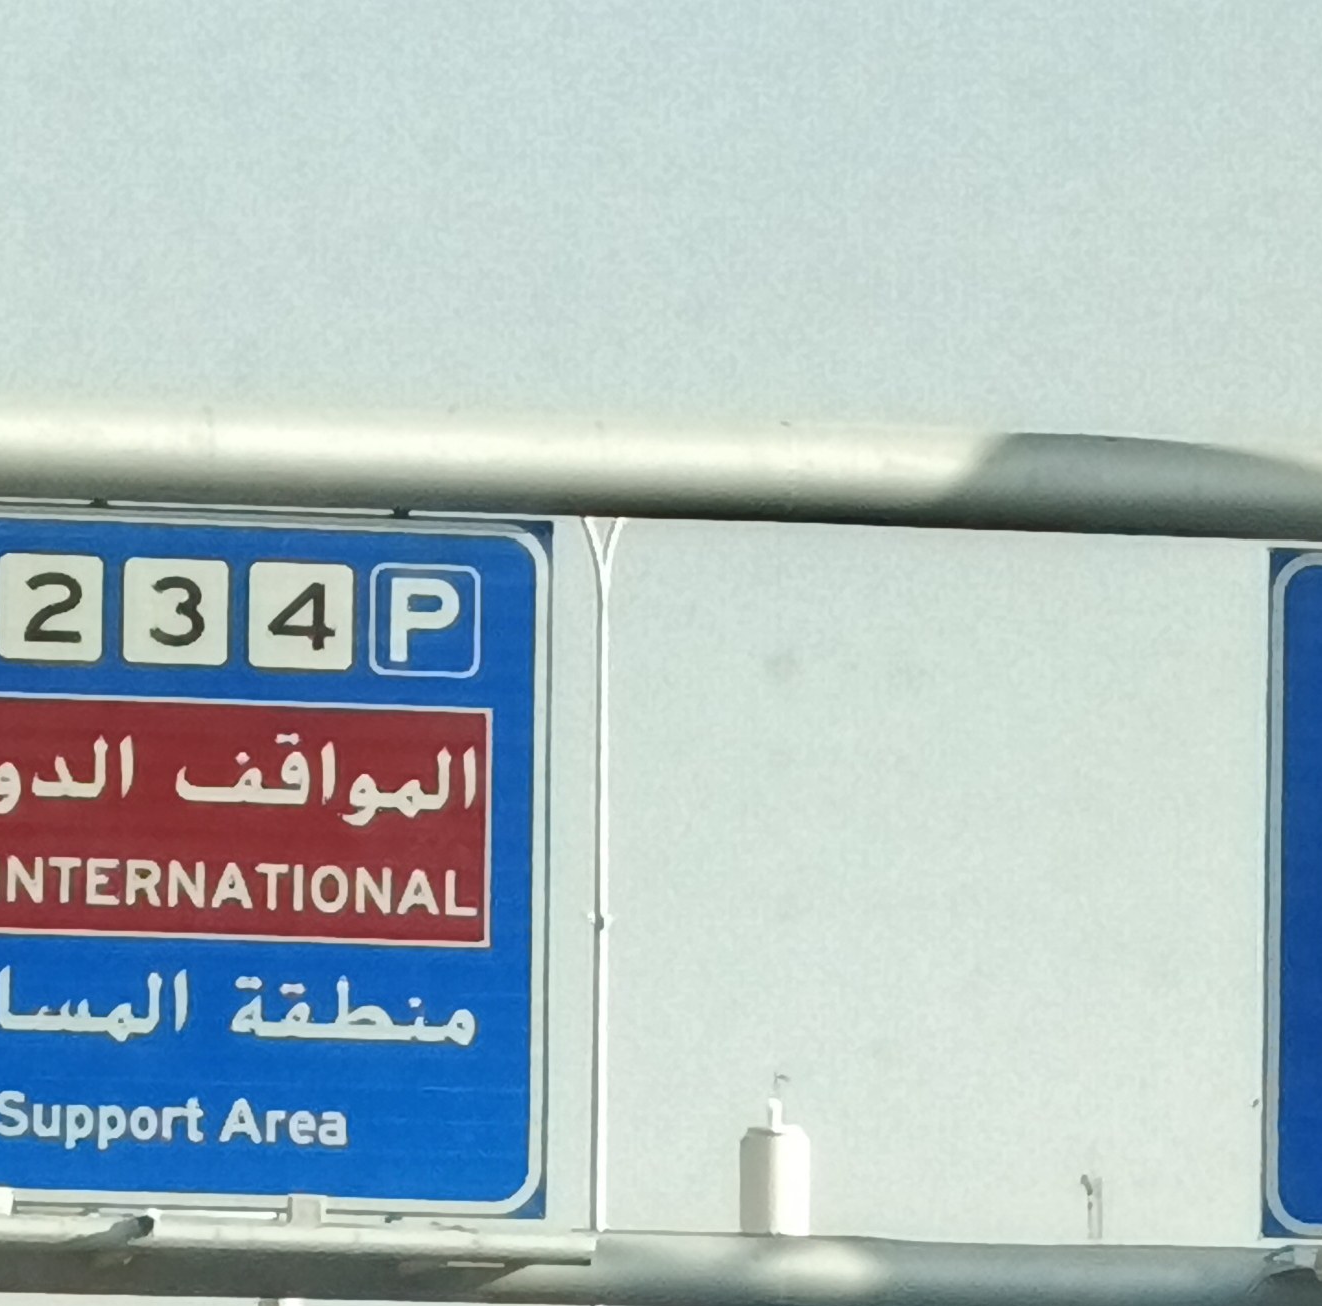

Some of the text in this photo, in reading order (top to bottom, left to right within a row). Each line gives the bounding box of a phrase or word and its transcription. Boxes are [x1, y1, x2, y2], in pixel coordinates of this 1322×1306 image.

[23, 571, 83, 644] 2
[149, 575, 206, 647] 3
[267, 582, 336, 651] 4
[389, 577, 461, 663] P
[175, 732, 478, 827] المواقف
[229, 975, 477, 1047] منطقة
[219, 1097, 348, 1147] Area
